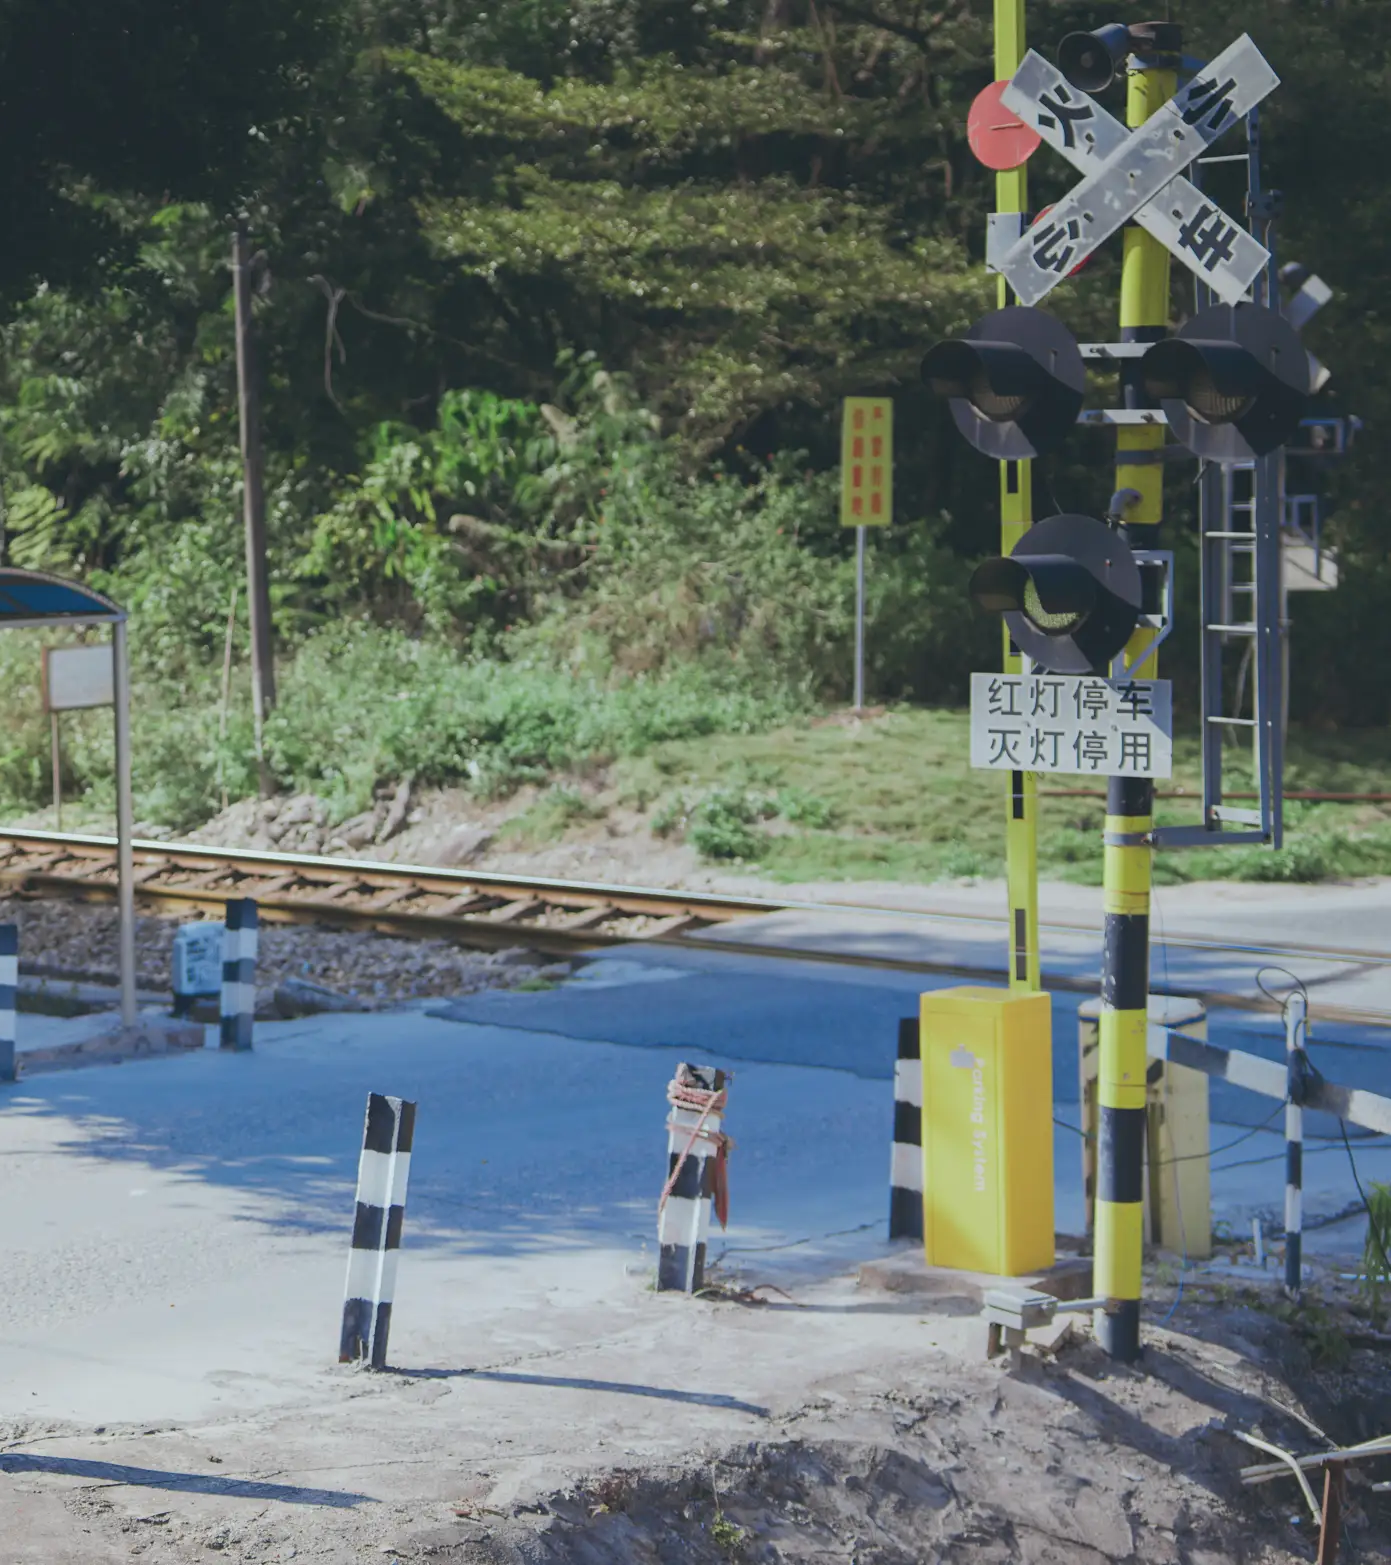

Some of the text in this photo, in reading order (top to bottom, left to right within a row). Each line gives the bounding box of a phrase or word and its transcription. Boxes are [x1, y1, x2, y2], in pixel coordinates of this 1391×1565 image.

[987, 677, 1153, 722] 红灯停车
[987, 727, 1152, 772] 灭灯停用
[969, 1057, 987, 1191] Parking System
